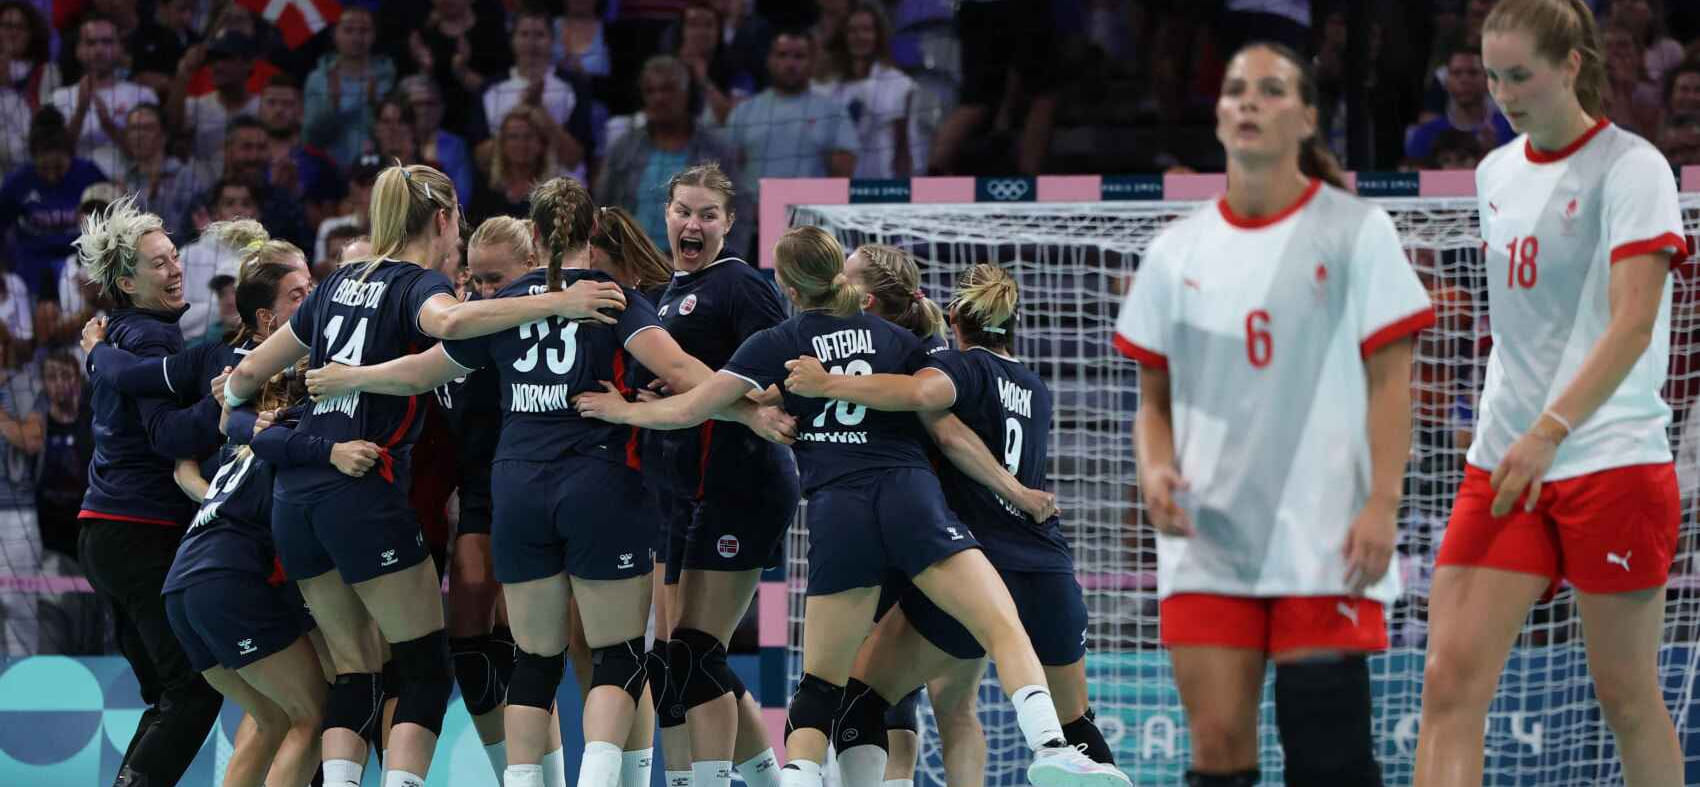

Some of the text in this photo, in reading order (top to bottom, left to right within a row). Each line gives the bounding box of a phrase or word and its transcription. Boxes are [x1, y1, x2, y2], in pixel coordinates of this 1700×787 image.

[1506, 235, 1539, 290] 18
[323, 315, 369, 367] 14
[812, 329, 876, 363] OFTEDAL
[1245, 309, 1273, 369] 6
[511, 383, 568, 413] NORWAY
[796, 431, 868, 445] ORWAY
[1004, 417, 1023, 477] 9
